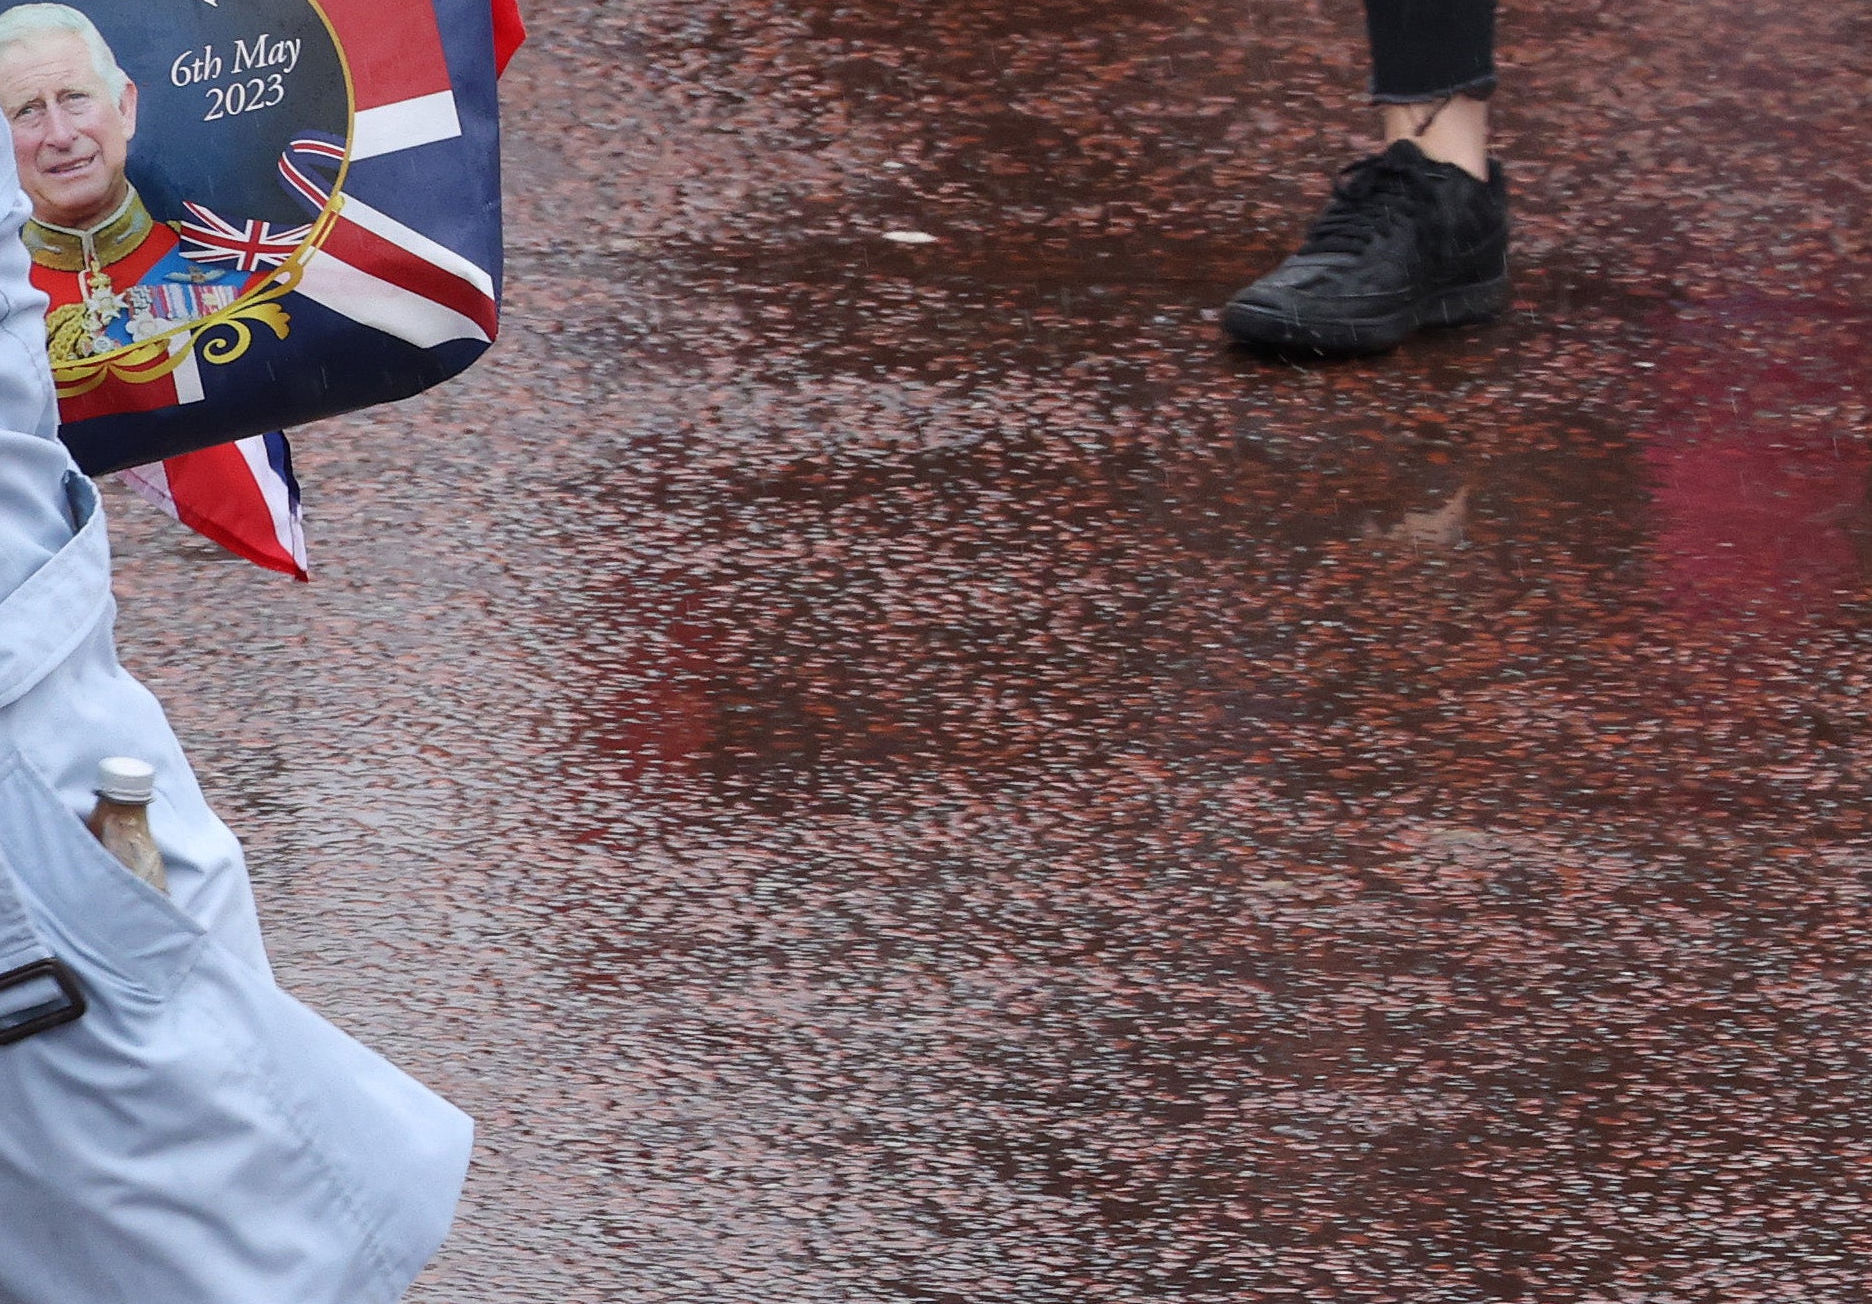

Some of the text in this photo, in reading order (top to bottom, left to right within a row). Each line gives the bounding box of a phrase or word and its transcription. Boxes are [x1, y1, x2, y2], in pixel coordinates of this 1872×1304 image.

[170, 34, 301, 87] 6th May
[203, 73, 285, 121] 2023
